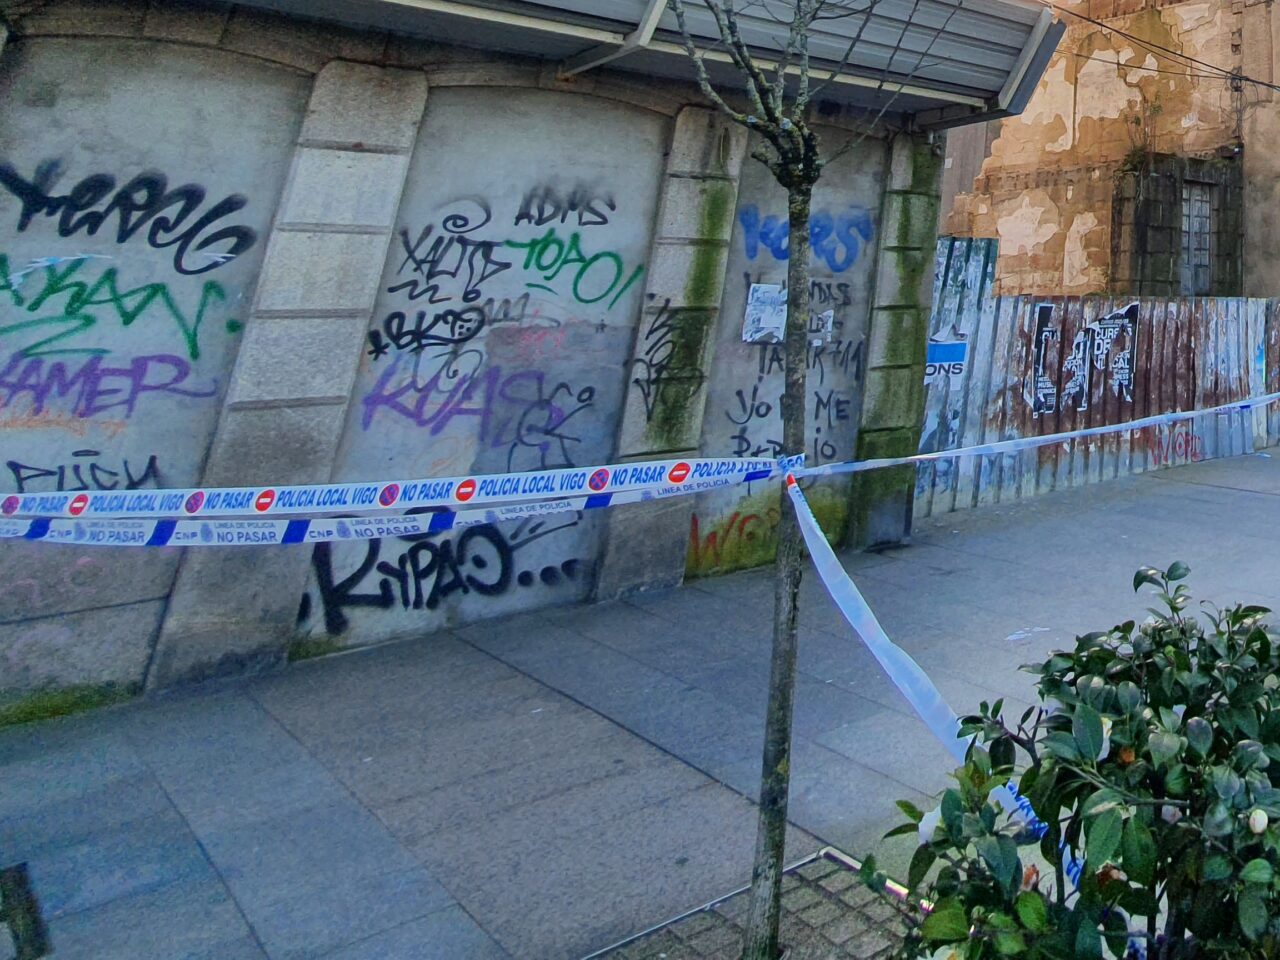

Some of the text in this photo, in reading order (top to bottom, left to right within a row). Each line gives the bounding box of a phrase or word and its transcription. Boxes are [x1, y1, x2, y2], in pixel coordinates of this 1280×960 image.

[89, 495, 126, 512] POLICIA
[126, 494, 158, 511] LOCAL
[159, 493, 185, 511] VIGO
[205, 492, 220, 509] NO
[220, 491, 254, 508] PASAR
[275, 489, 316, 507] POLICIA
[316, 488, 350, 506] LOCAL
[351, 486, 378, 504] VIGO
[400, 484, 417, 502] NO
[417, 481, 453, 501] PASAR
[478, 477, 522, 496] POLICIA
[522, 475, 556, 494] LOCAL
[559, 472, 586, 490] VIGO
[611, 468, 626, 486] NO
[628, 465, 666, 484] PASAR
[691, 461, 738, 478] POLICIA
[657, 478, 730, 496] LINEA DE POLICIA
[539, 501, 572, 511] POLICIA
[90, 530, 146, 543] NO PASAR
[217, 531, 276, 542] NO PASAR
[355, 525, 421, 538] NO PASAR
